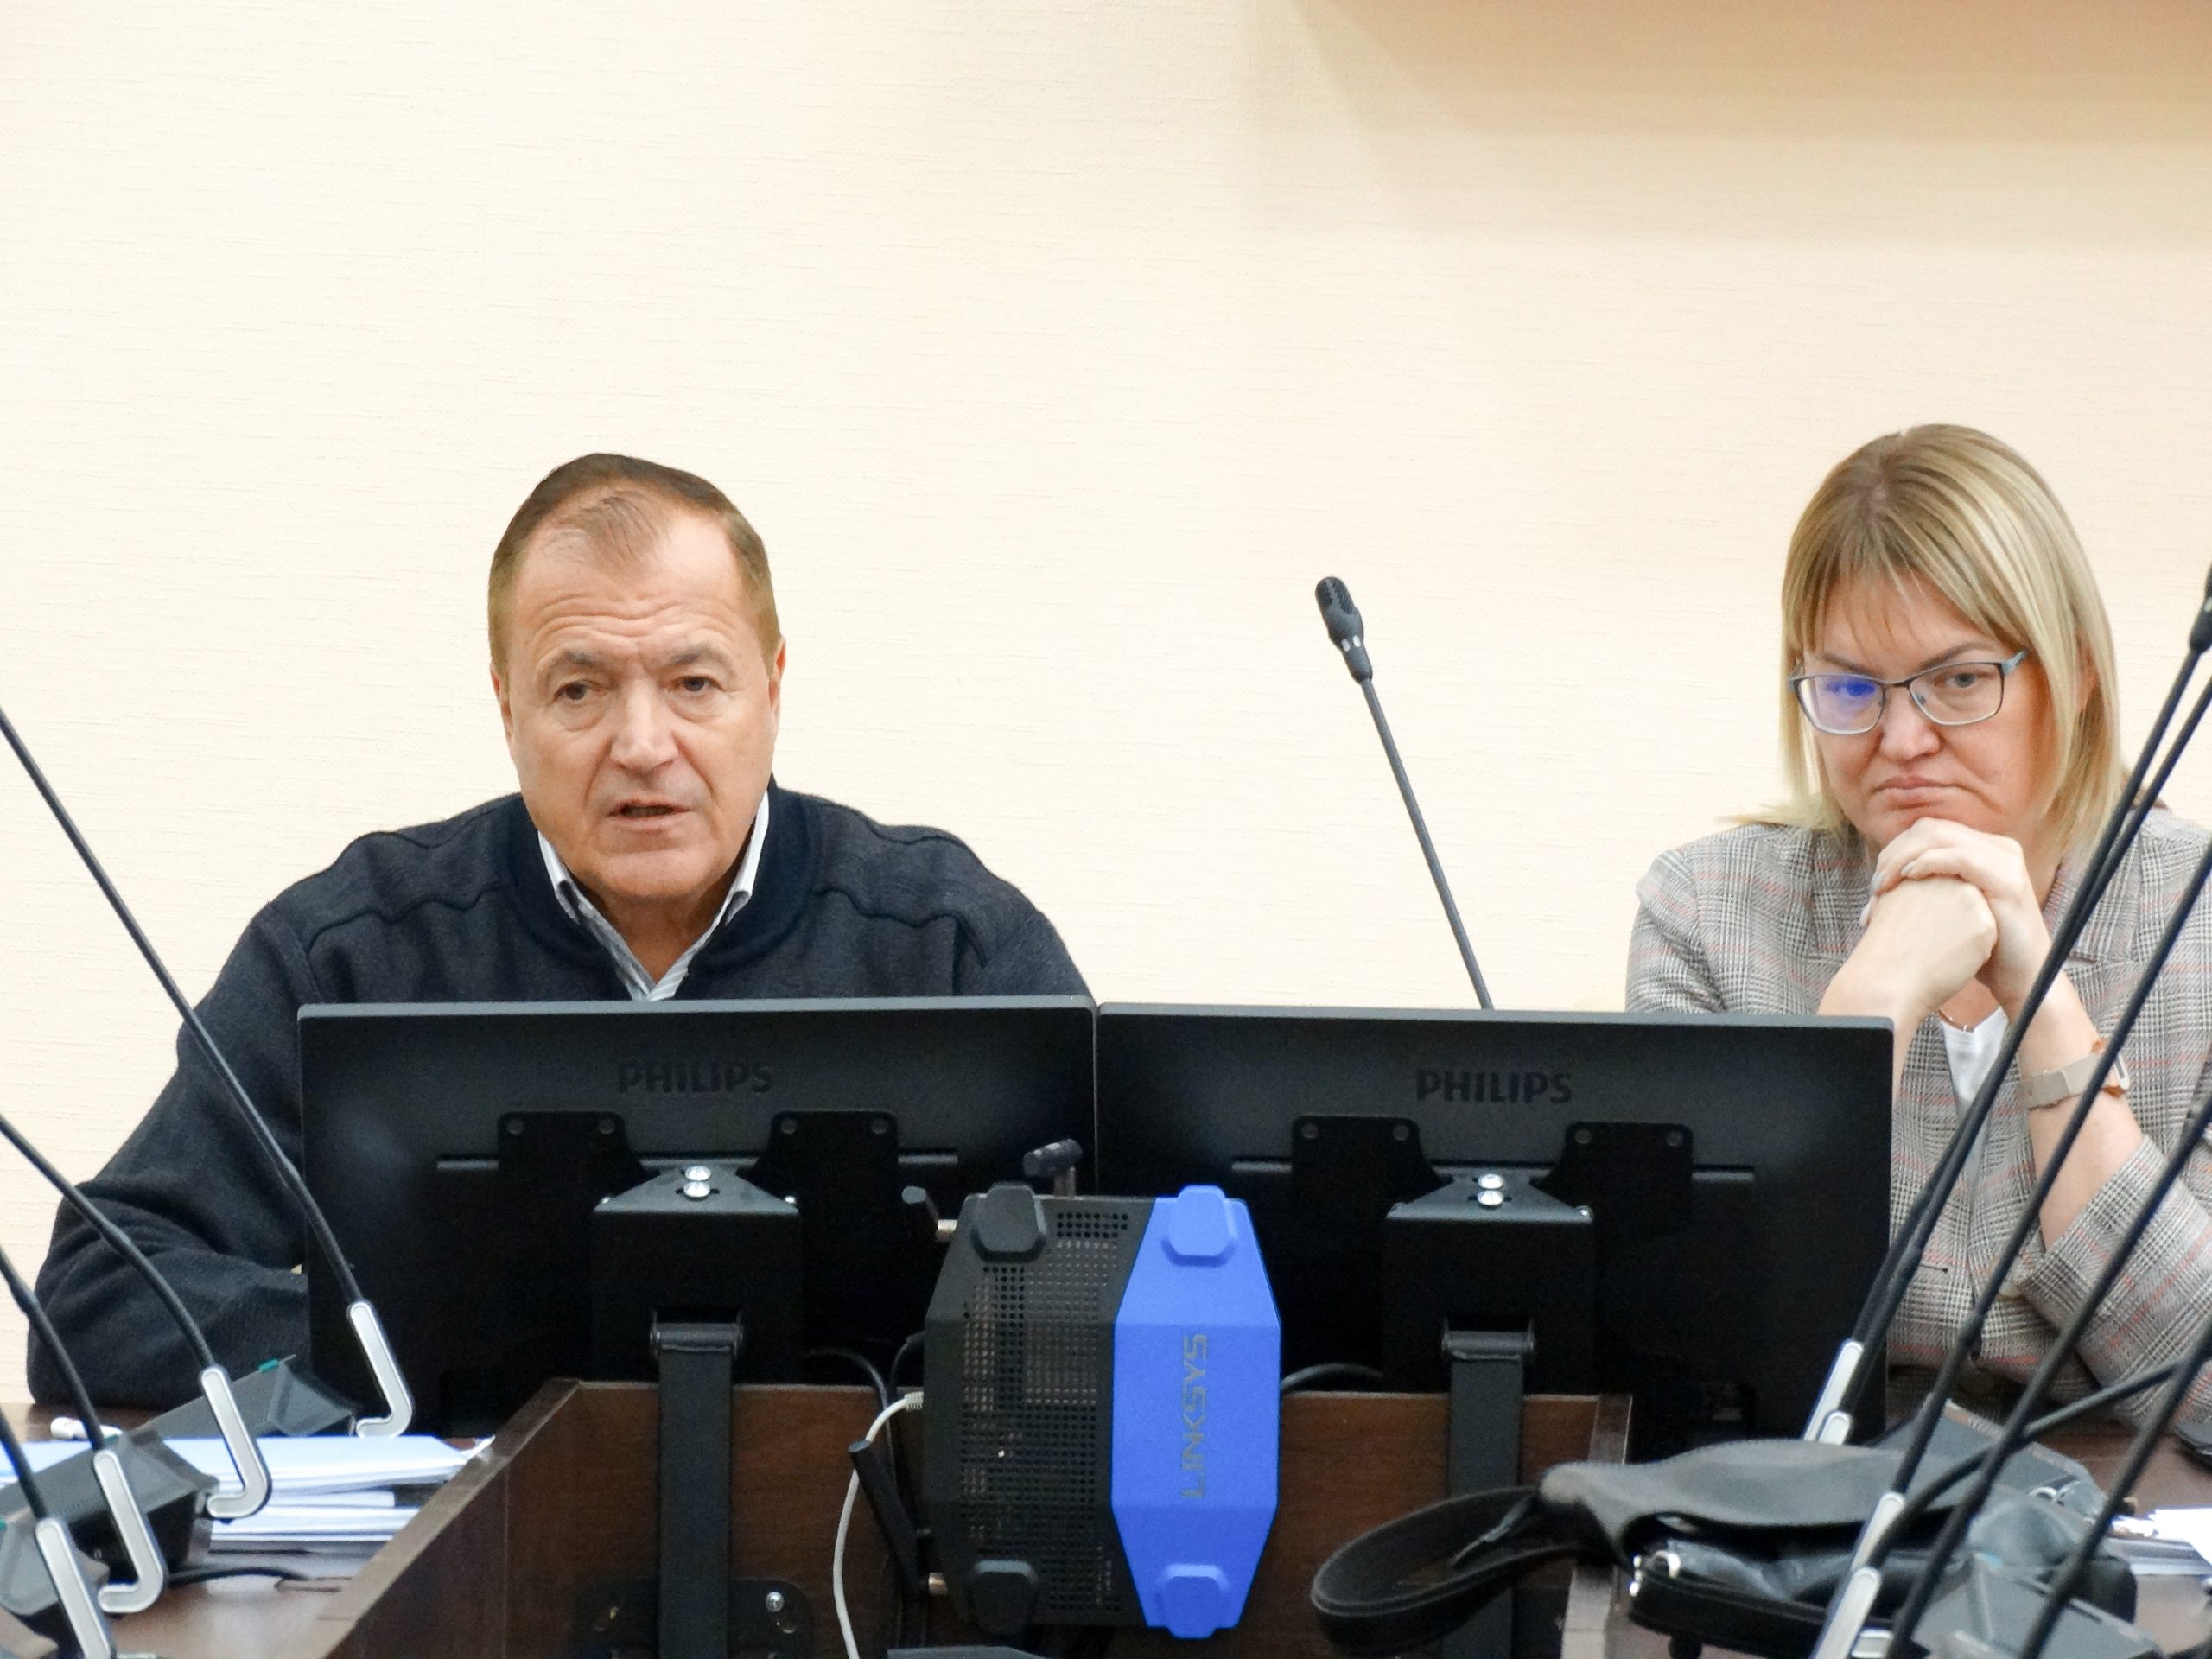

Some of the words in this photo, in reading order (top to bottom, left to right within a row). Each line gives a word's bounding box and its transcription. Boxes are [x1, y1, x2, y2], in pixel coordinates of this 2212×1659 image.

[619, 1062, 772, 1093] PHILIPS
[1417, 1071, 1573, 1103] PHILIPS
[1182, 1334, 1208, 1498] LINKSYS
